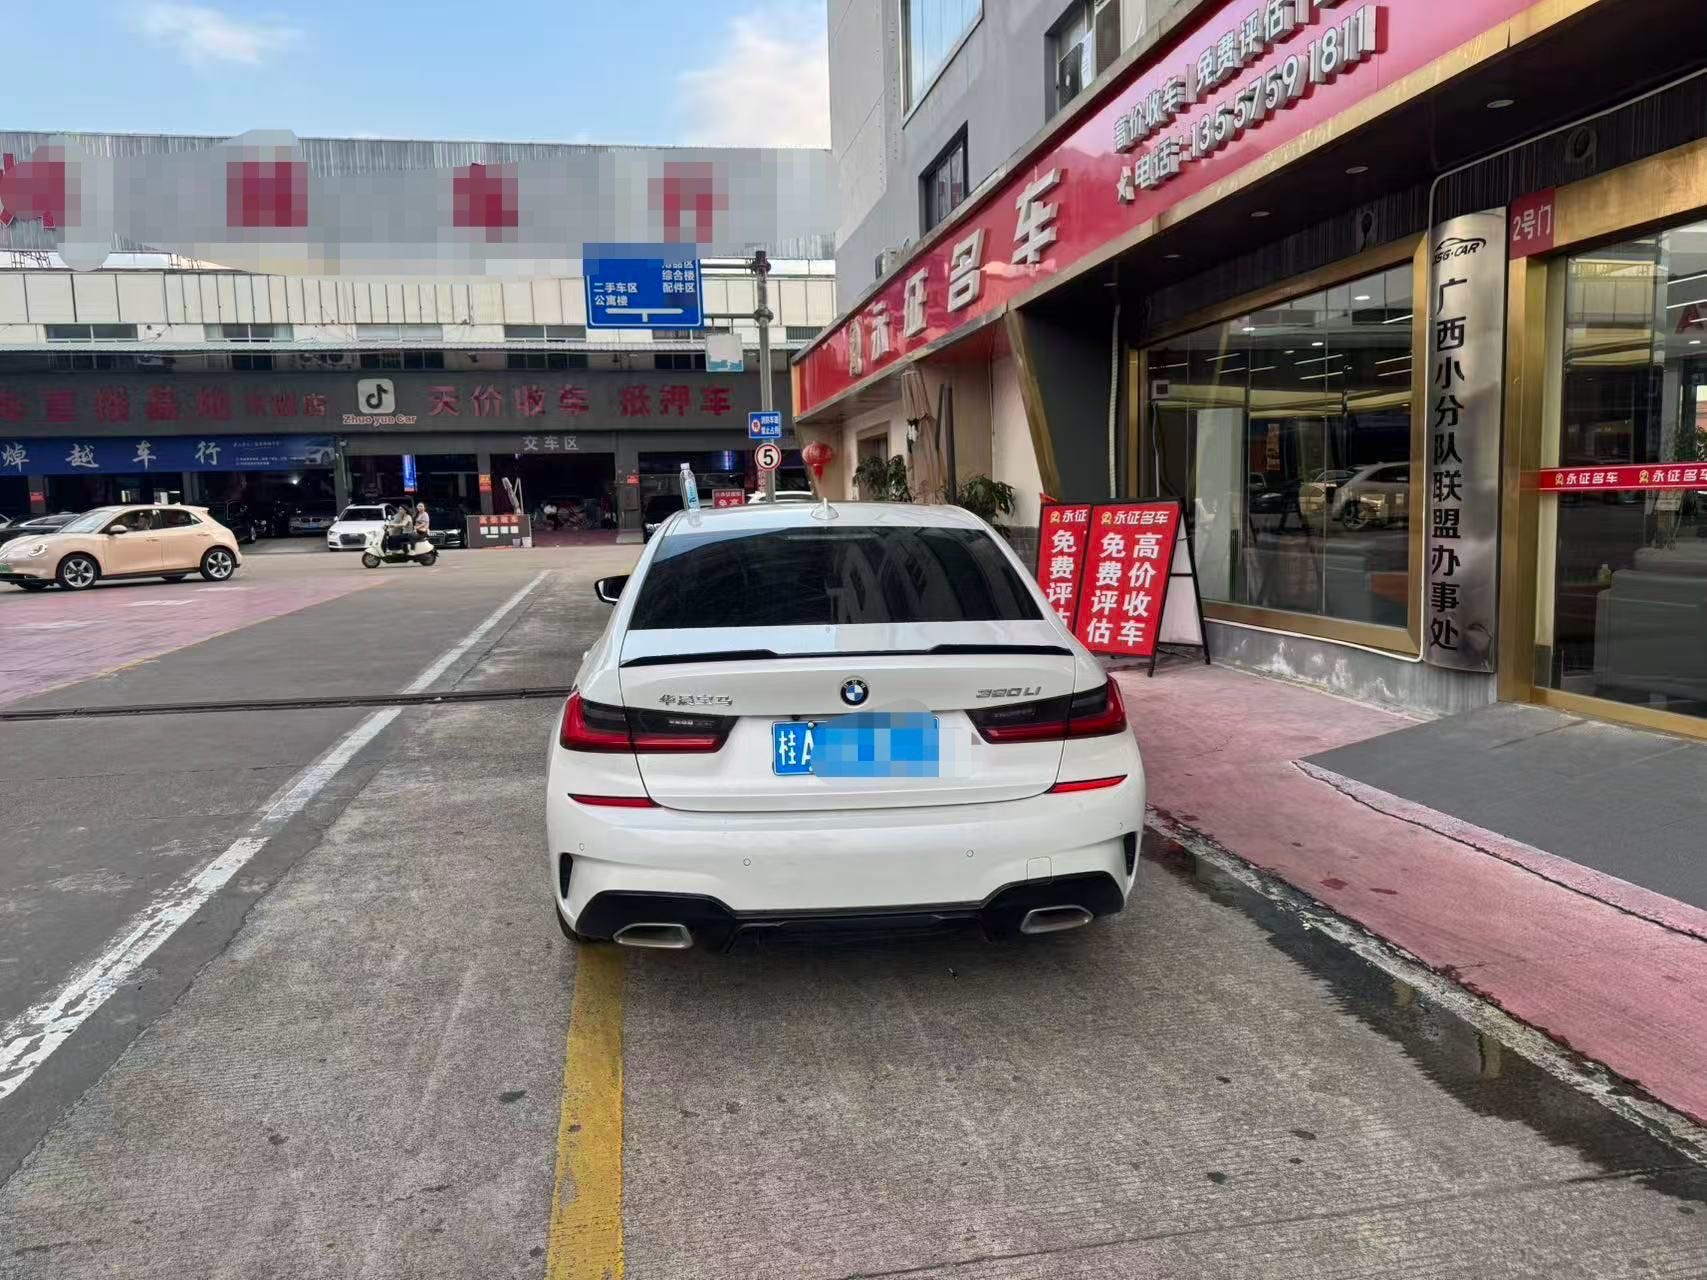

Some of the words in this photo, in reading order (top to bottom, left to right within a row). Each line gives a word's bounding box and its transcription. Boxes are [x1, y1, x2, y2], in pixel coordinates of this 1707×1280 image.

[1512, 203, 1553, 242] 2号门
[662, 270, 696, 281] 综合楼
[593, 282, 638, 294] 二手车区
[662, 282, 696, 294] 配件区
[594, 295, 629, 306] 公寓楼
[427, 385, 592, 417] 天价收车
[619, 384, 735, 417] 抵押车
[523, 436, 580, 451] 交车区
[763, 449, 774, 466] 5
[1430, 278, 1468, 651] 广西小分队联盟办事处
[1566, 472, 1619, 485] 永征名车
[1113, 511, 1170, 525] 永征名车
[1086, 532, 1127, 644] 免费评估
[1116, 532, 1164, 647] 高价收车
